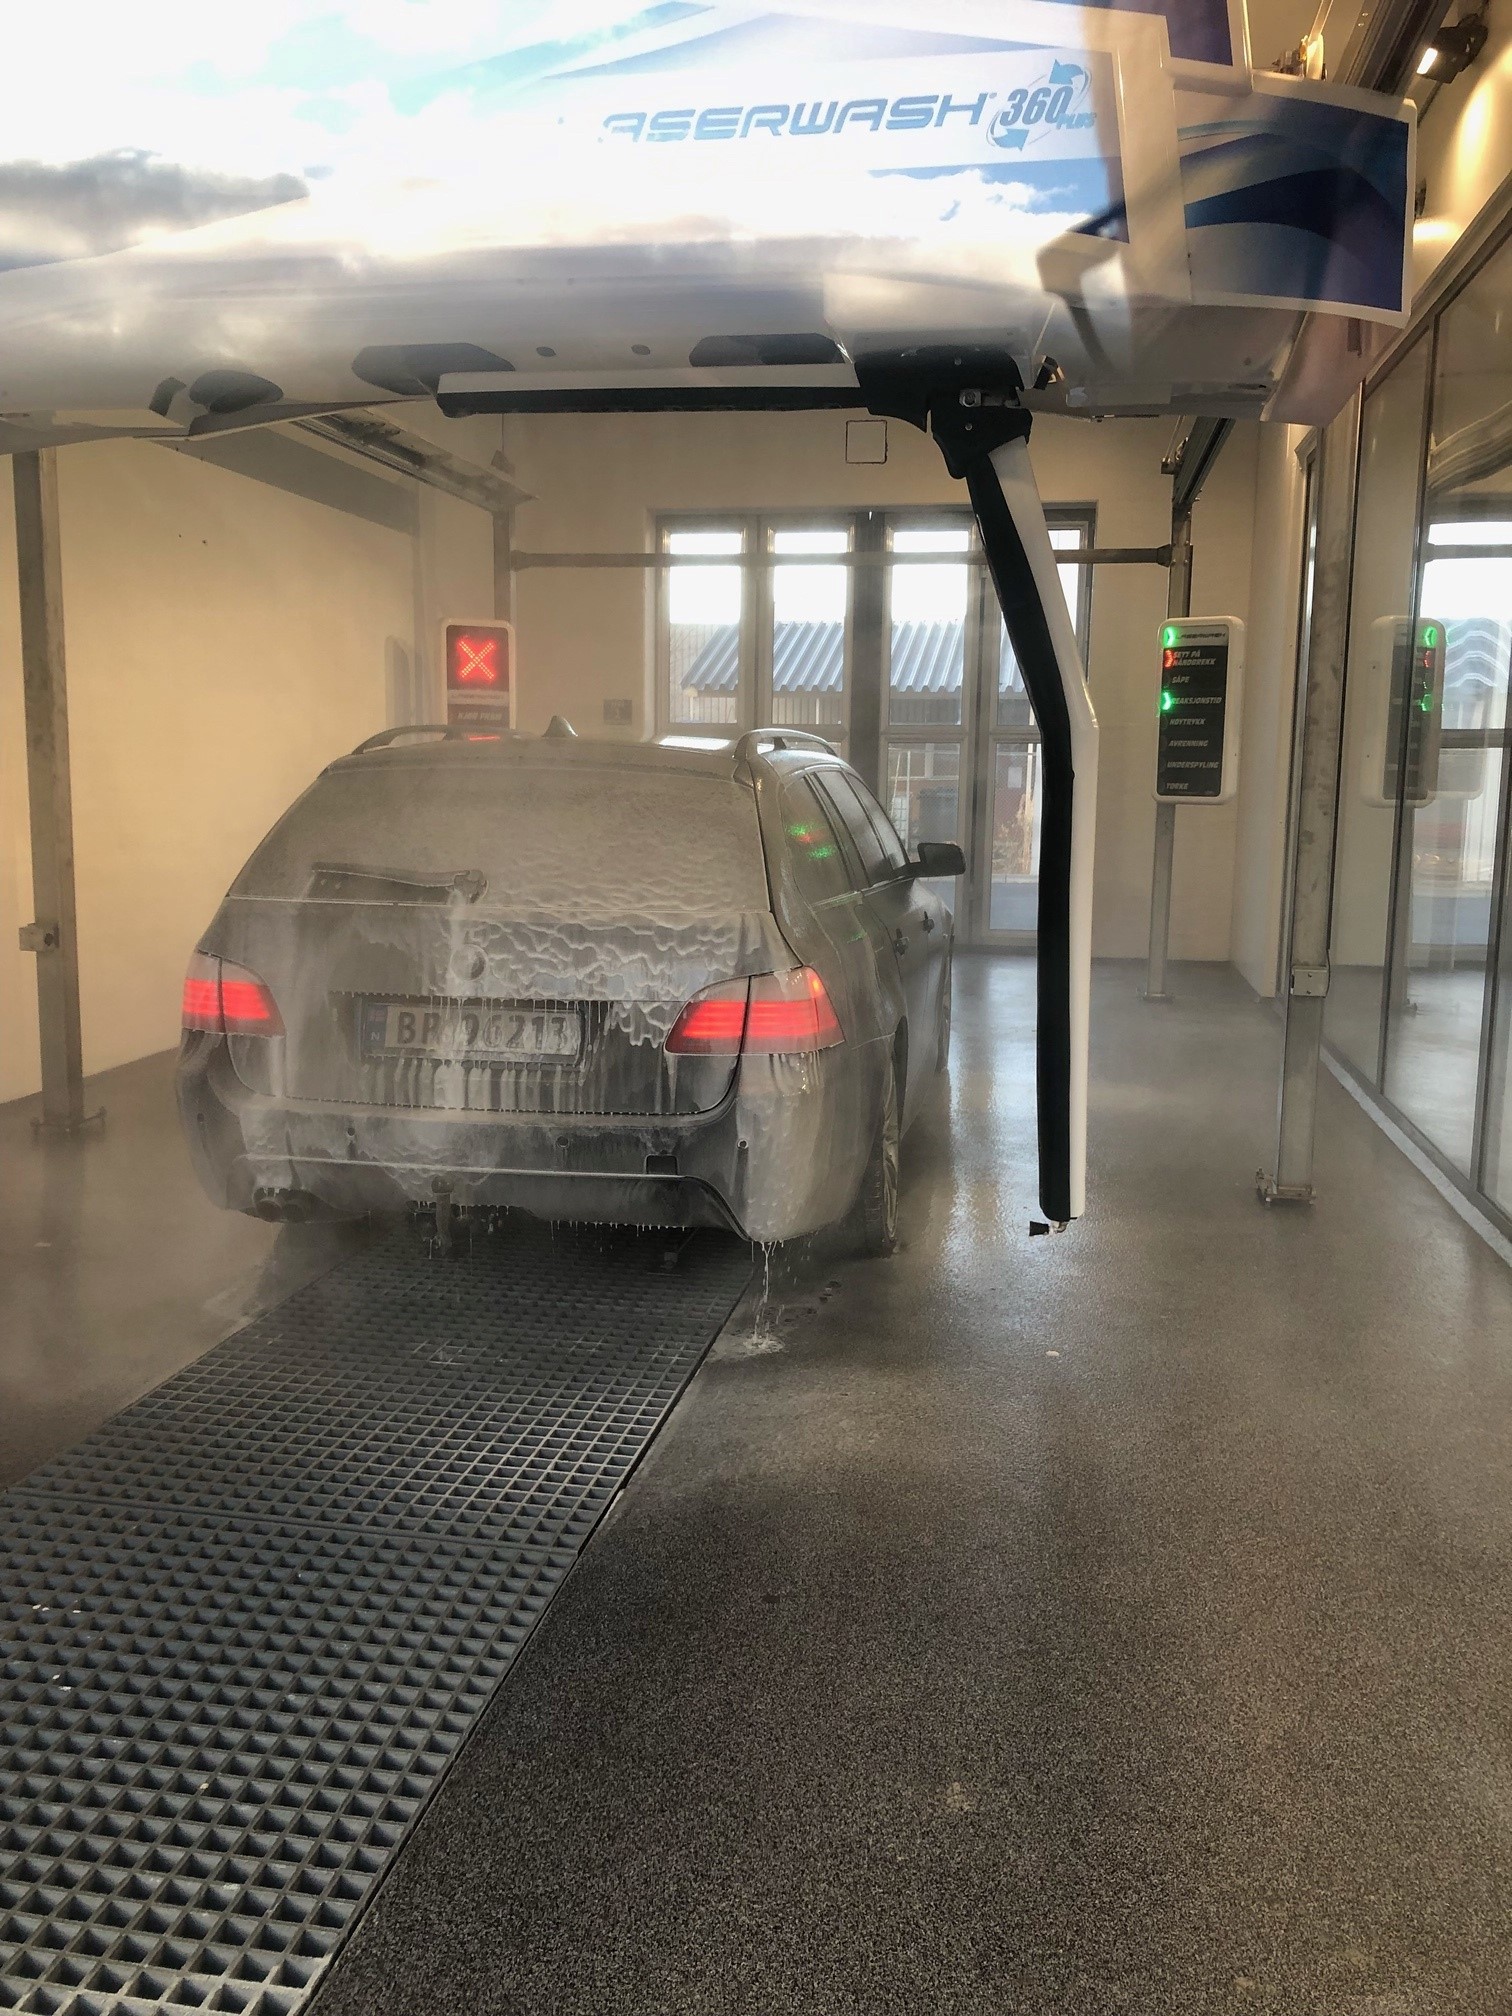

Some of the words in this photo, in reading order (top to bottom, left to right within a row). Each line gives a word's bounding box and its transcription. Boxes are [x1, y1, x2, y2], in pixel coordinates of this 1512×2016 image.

[597, 92, 989, 142] ASERWASH
[999, 86, 1074, 126] 360
[1172, 675, 1190, 683] SÅPE
[370, 1031, 381, 1042] N
